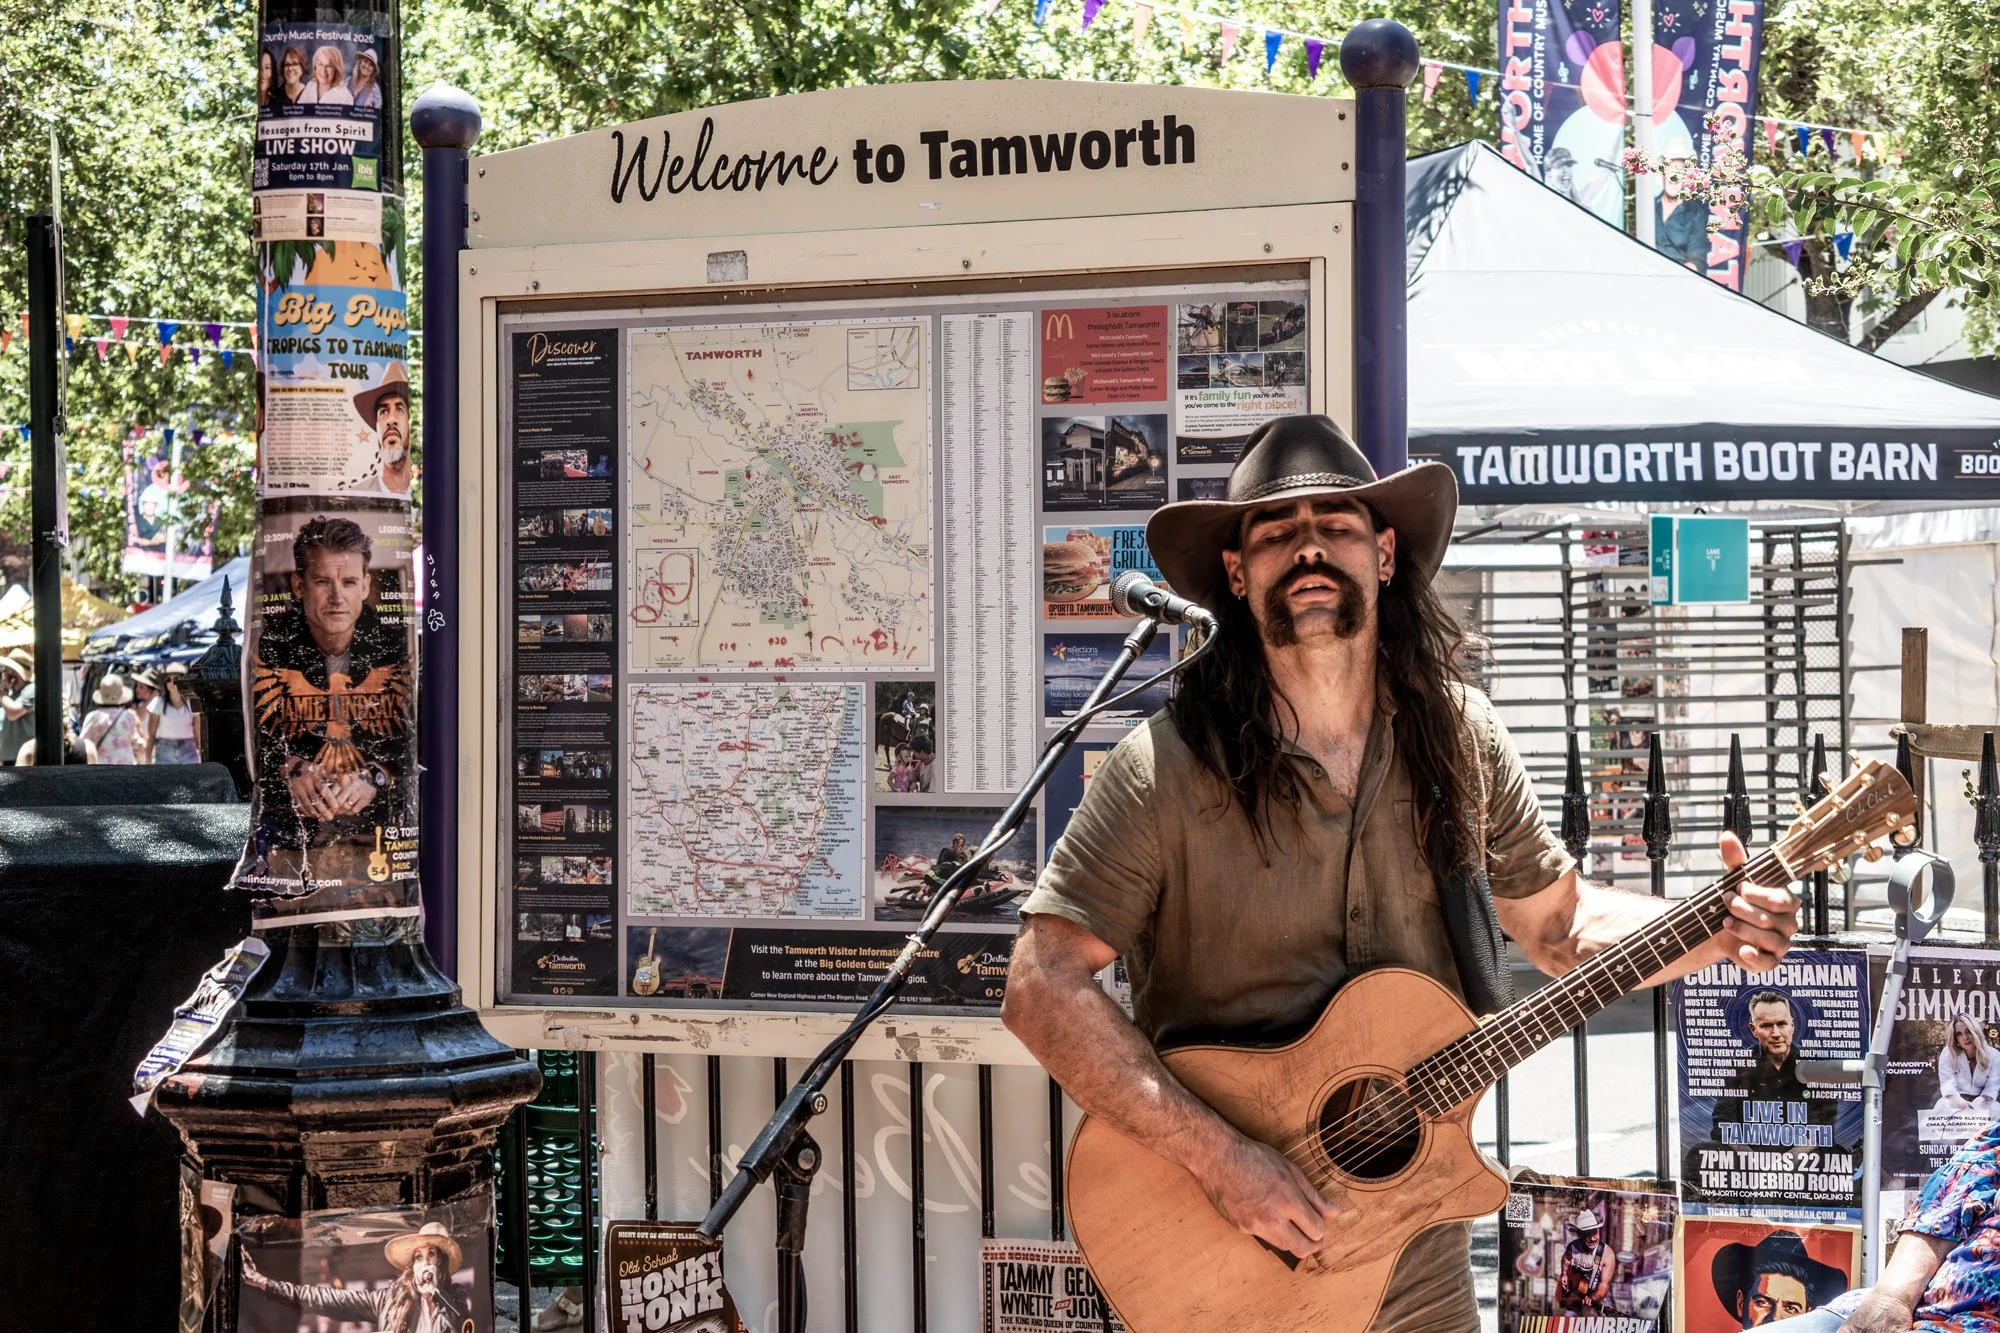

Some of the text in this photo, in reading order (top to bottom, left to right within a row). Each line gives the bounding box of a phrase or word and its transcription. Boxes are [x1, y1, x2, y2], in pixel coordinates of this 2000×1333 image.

[289, 30, 375, 43] Music Festival 2026
[1533, 33, 1546, 164] HOME OF COUNTRY
[304, 123, 331, 134] from
[335, 124, 367, 137] Spirit
[266, 138, 356, 155] LIVE SHOW
[610, 114, 1196, 203] Welcome to Tamworth
[271, 161, 348, 172] Saturday 17th Jan
[274, 292, 336, 335] Big
[1088, 321, 1160, 331] throughout Tamworth!
[267, 338, 408, 360] TROPICS TO TAMWORT
[527, 333, 597, 367] Discover
[685, 349, 763, 361] TAMWORTH
[328, 362, 369, 380] TOUR
[1199, 390, 1252, 402] family fun
[1237, 399, 1297, 411] right place!
[1456, 441, 1938, 485] TAMWORTH BOOT BARN
[1961, 454, 2000, 474] BOO
[1113, 530, 1146, 550] FRES
[1113, 550, 1158, 569] GRILLE
[270, 592, 292, 601] JAYNE
[376, 605, 401, 613] WESTS
[1048, 603, 1113, 613] OPORTO TAMWORTH
[1067, 646, 1099, 655] reflections
[278, 696, 326, 722] JAMIE
[384, 841, 419, 851] TAMWORT
[371, 867, 386, 876] 54
[392, 862, 411, 870] MUSIC
[751, 944, 857, 956] Visit the Tamworth Visitor
[549, 962, 586, 970] Tamworth
[794, 959, 866, 969] at the Big Golden
[762, 971, 855, 982] to learn more about the
[1684, 964, 1857, 987] COLIN BUCHANAN
[1684, 989, 1737, 997] ONE SHOW ONLY
[1792, 990, 1858, 998] NASHVILLE'S FINEST
[1684, 999, 1717, 1007] MUST SEE
[1812, 1000, 1859, 1008] SONGMASTER
[1895, 988, 2000, 1024] SIMMON
[1706, 1009, 1724, 1017] MISS
[1824, 1010, 1859, 1018] BEST EVER
[1697, 1019, 1726, 1027] REGRETS
[1808, 1019, 1860, 1029] AUSSIE GROWN
[1687, 1028, 1731, 1037] LAST CHANCE
[1815, 1029, 1860, 1038] VINE RIPENED
[1687, 1038, 1742, 1047] THIS MEANS YOU
[1801, 1039, 1860, 1049] VIRAL SENSATION
[1687, 1048, 1753, 1057] WORTH EVERY CENT
[1800, 1049, 1861, 1059] DOLPHIN FRIENDLY
[1688, 1058, 1757, 1067] DIRECT FROM THE US
[1688, 1068, 1737, 1077] LIVING LEGEND
[1688, 1078, 1725, 1087] HIT MAKER
[1689, 1088, 1723, 1096] REKNOWN
[1815, 1091, 1842, 1099] ACCEPT
[1743, 1100, 1808, 1124] LIVE IN
[1719, 1122, 1833, 1147] TAMWORTH
[1919, 1144, 1948, 1155] SUNDAY
[1699, 1150, 1853, 1173] 7PM THURS 22 JAN
[1930, 1158, 1943, 1168] THE
[1699, 1171, 1854, 1193] THE BLUEBIRD ROOM
[1700, 1189, 1738, 1197] TAMWORTH
[1739, 1190, 1782, 1199] COMMUNITY
[1784, 1192, 1813, 1200] CENTRE,
[1707, 1207, 1847, 1221] TICKETS AT COLINBUCHANAN.COM.AU
[619, 1247, 679, 1277] Old School
[982, 1252, 1041, 1262] THE SONGS
[620, 1249, 723, 1305] HONKY
[997, 1262, 1055, 1295] TAMMY
[621, 1277, 724, 1333] TONK
[1000, 1292, 1055, 1318] WYNETTE
[1000, 1316, 1104, 1330] THE KING AND QUEEN OF COUNTRY
